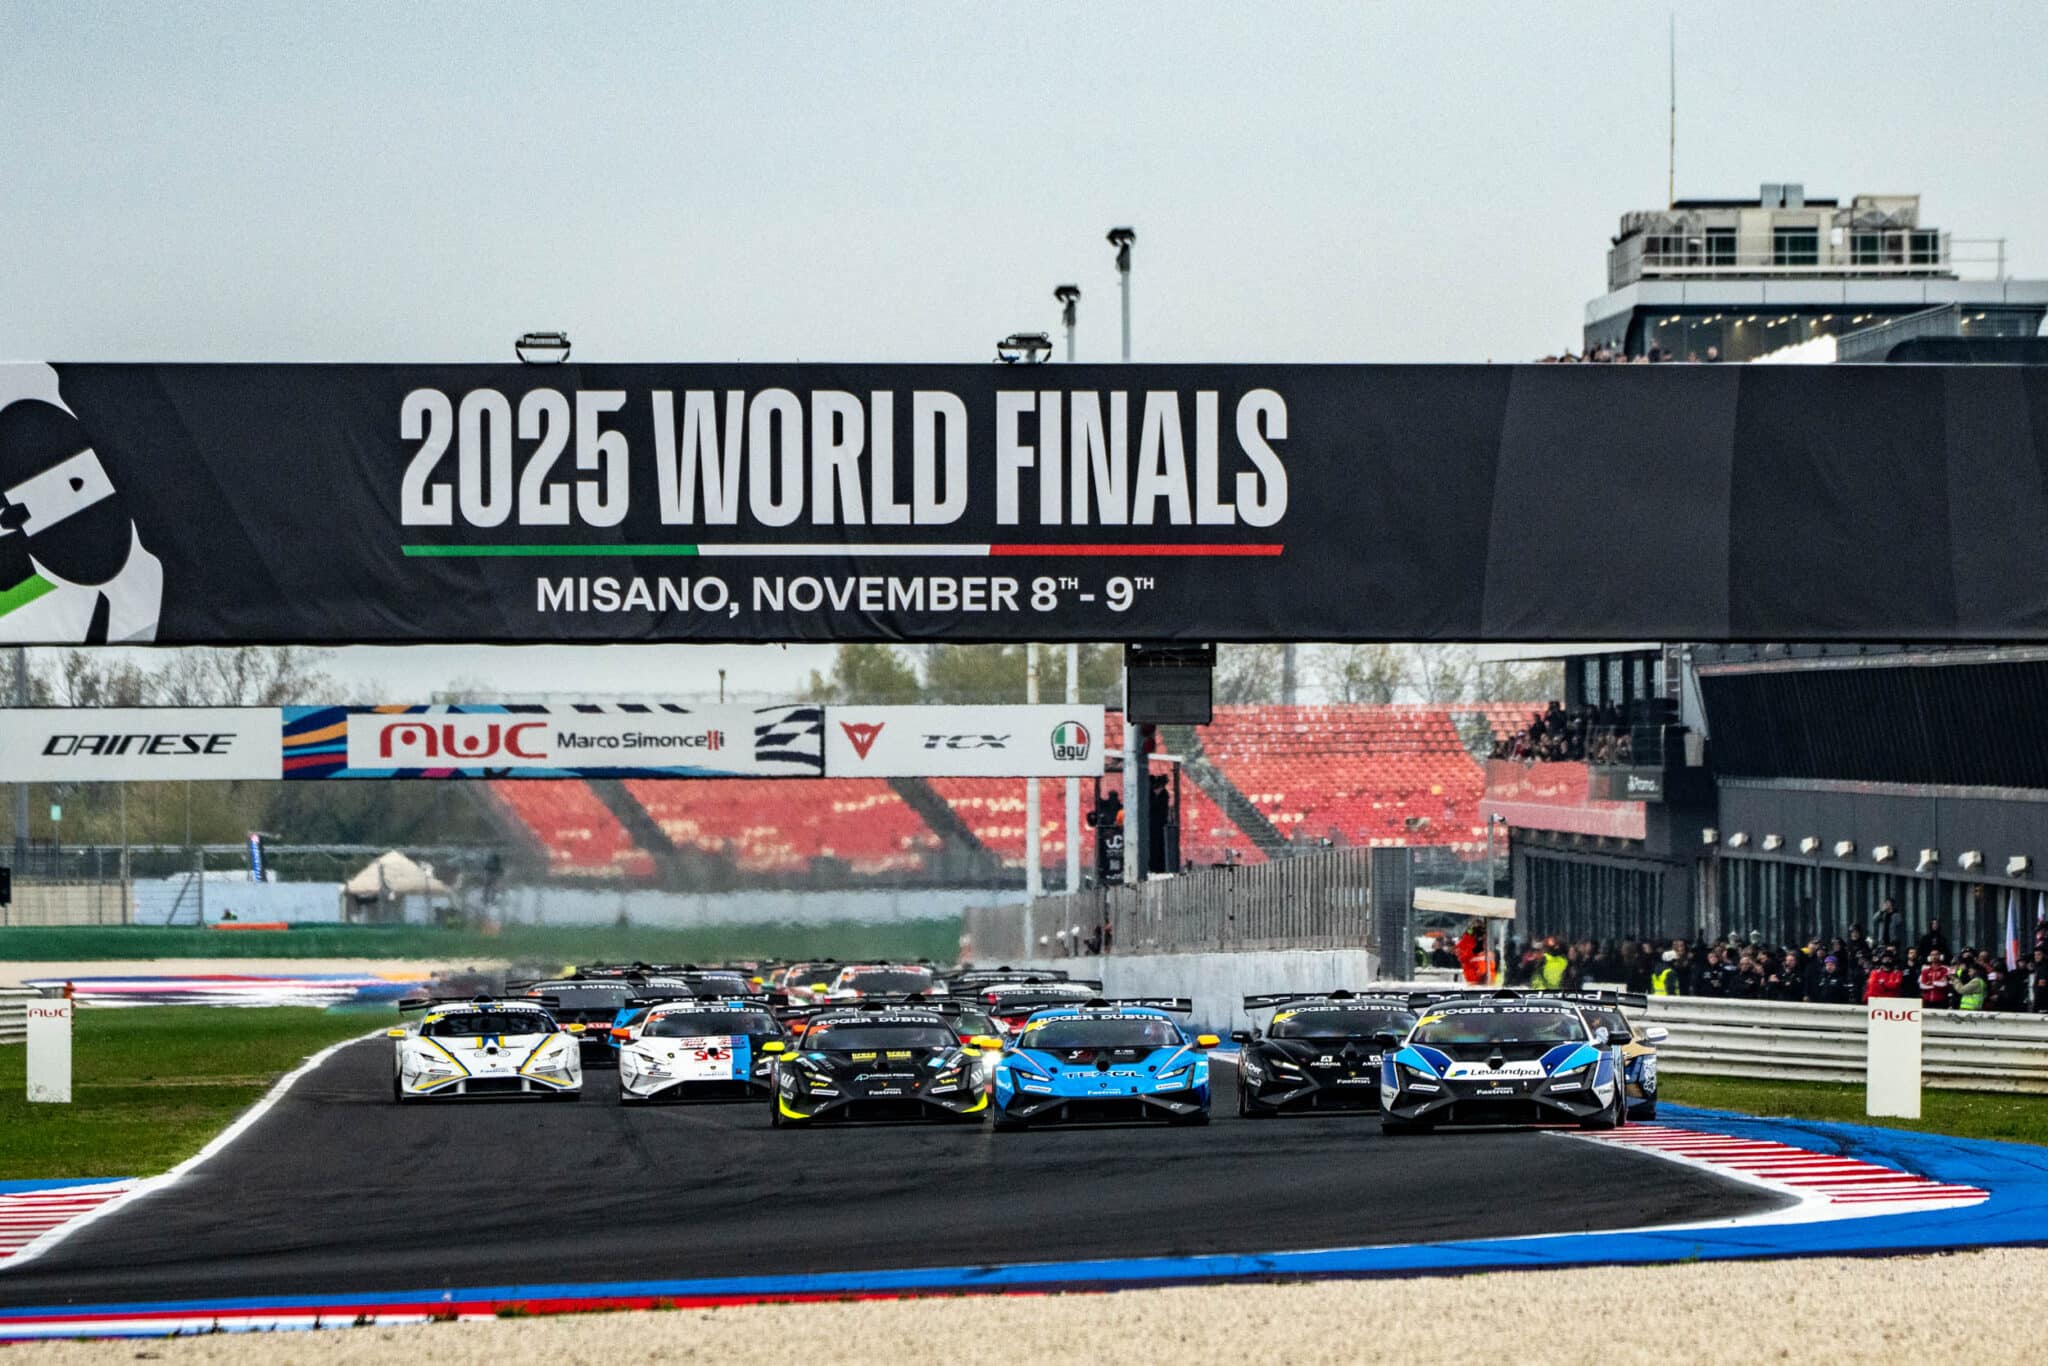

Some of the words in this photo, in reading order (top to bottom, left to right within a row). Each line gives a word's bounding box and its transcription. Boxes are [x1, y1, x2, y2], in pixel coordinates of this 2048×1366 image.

[401, 388, 629, 528] 2025
[651, 388, 968, 527] WORLD
[996, 388, 1288, 528] FINALS
[537, 576, 740, 619] MISANO,
[753, 576, 1020, 612] NOVEMBER
[42, 733, 237, 755] DAINESE
[557, 732, 620, 749] Marco
[622, 730, 725, 751] Simoncelli
[921, 734, 1012, 749] TCX
[1057, 744, 1085, 761] agv
[710, 1006, 764, 1014] DUBUIS
[1285, 1006, 1341, 1014] ROGER
[1347, 1005, 1408, 1013] DUBUIS
[1432, 1006, 1495, 1016] ROGER
[1502, 1006, 1571, 1015] DUBUIS
[816, 1017, 872, 1025] ROGER
[877, 1016, 939, 1024] DUBUIS
[1037, 1014, 1094, 1023] ROGER
[1470, 1067, 1542, 1078] Lewandpol
